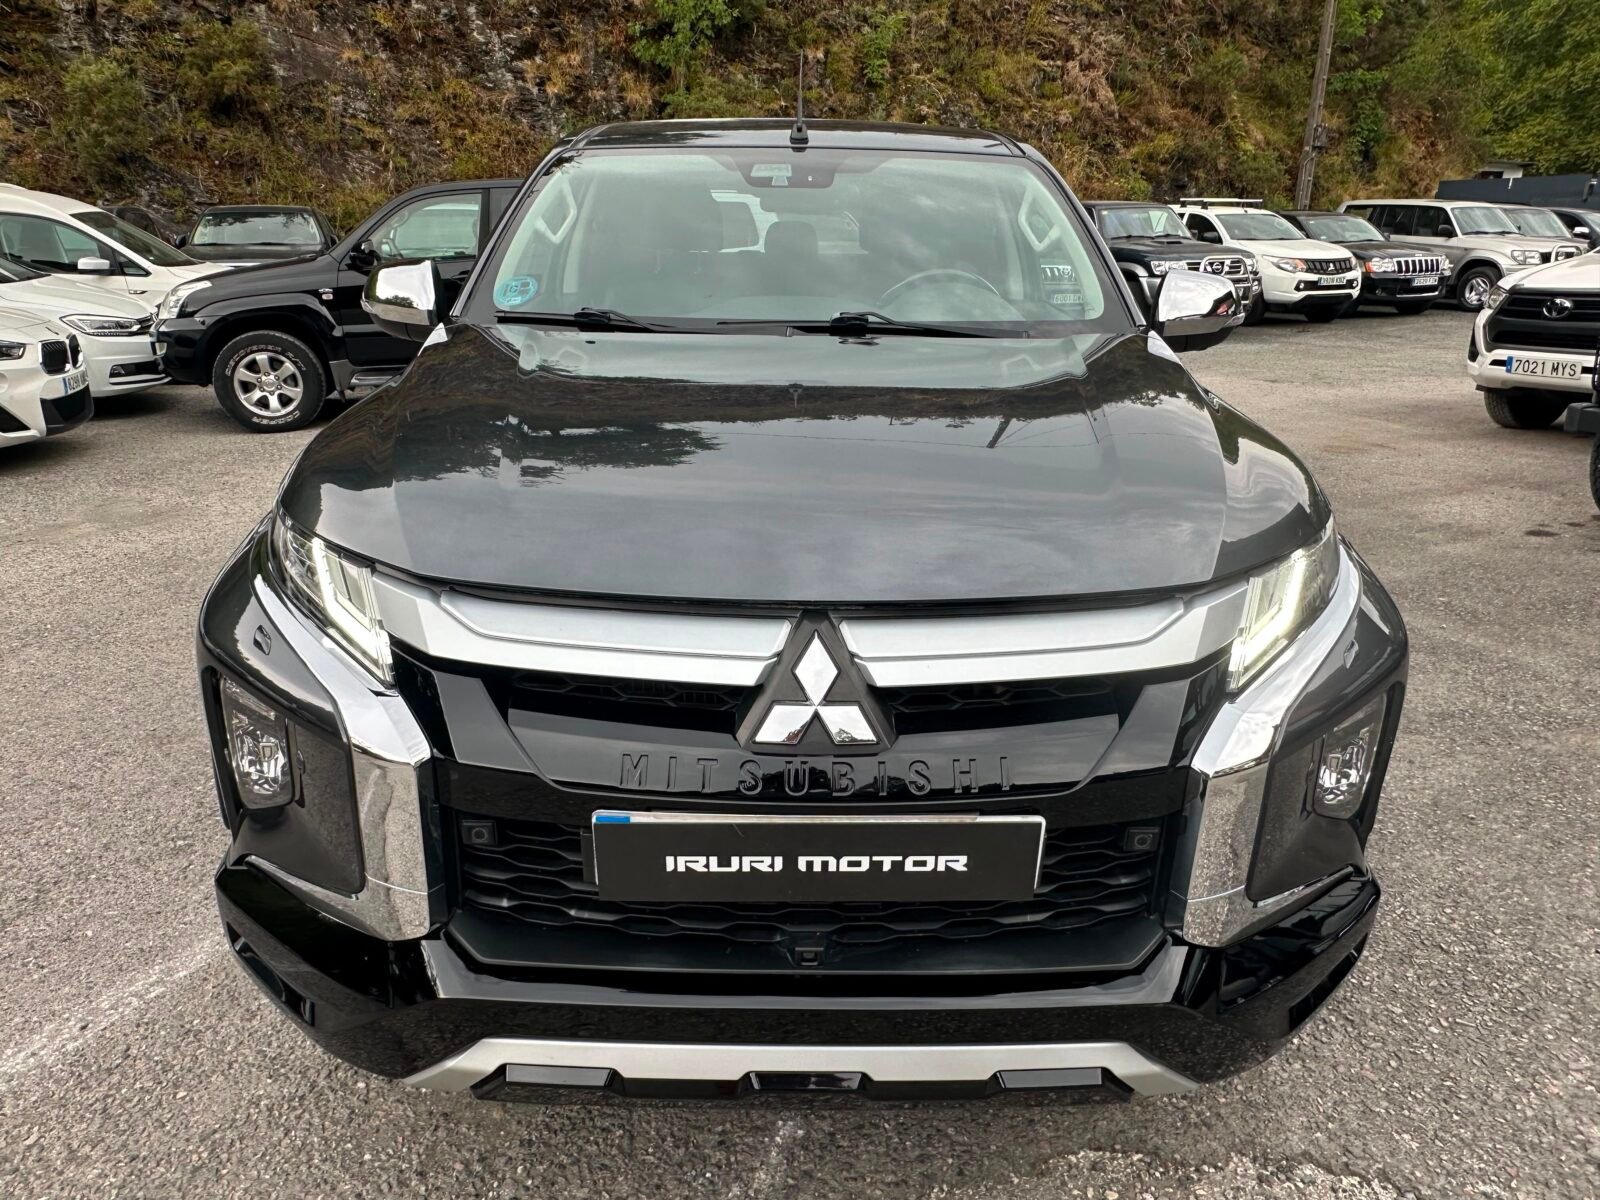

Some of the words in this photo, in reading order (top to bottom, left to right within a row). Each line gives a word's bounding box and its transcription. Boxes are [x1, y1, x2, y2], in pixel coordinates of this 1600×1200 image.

[1514, 359, 1546, 375] 7021
[1550, 361, 1577, 377] MYS
[619, 752, 1011, 797] MITSUBISHI
[665, 855, 784, 873] IRURI
[797, 855, 969, 873] MOTOR
